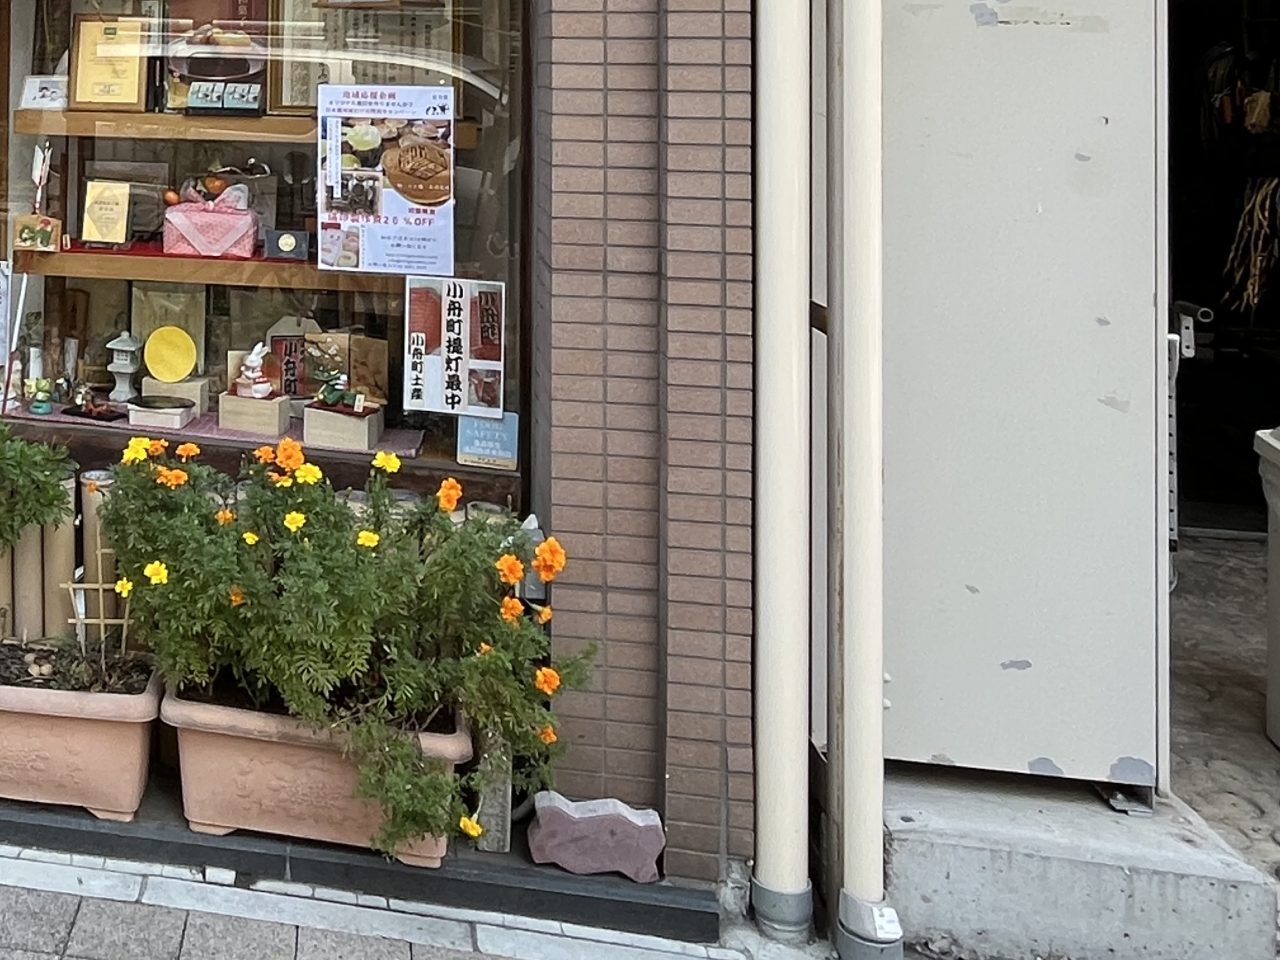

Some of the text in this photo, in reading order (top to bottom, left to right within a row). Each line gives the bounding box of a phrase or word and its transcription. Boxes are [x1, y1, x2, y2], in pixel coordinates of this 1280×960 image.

[410, 334, 425, 400] 小舟町土産
[445, 281, 464, 411] 小舟町提灯最中
